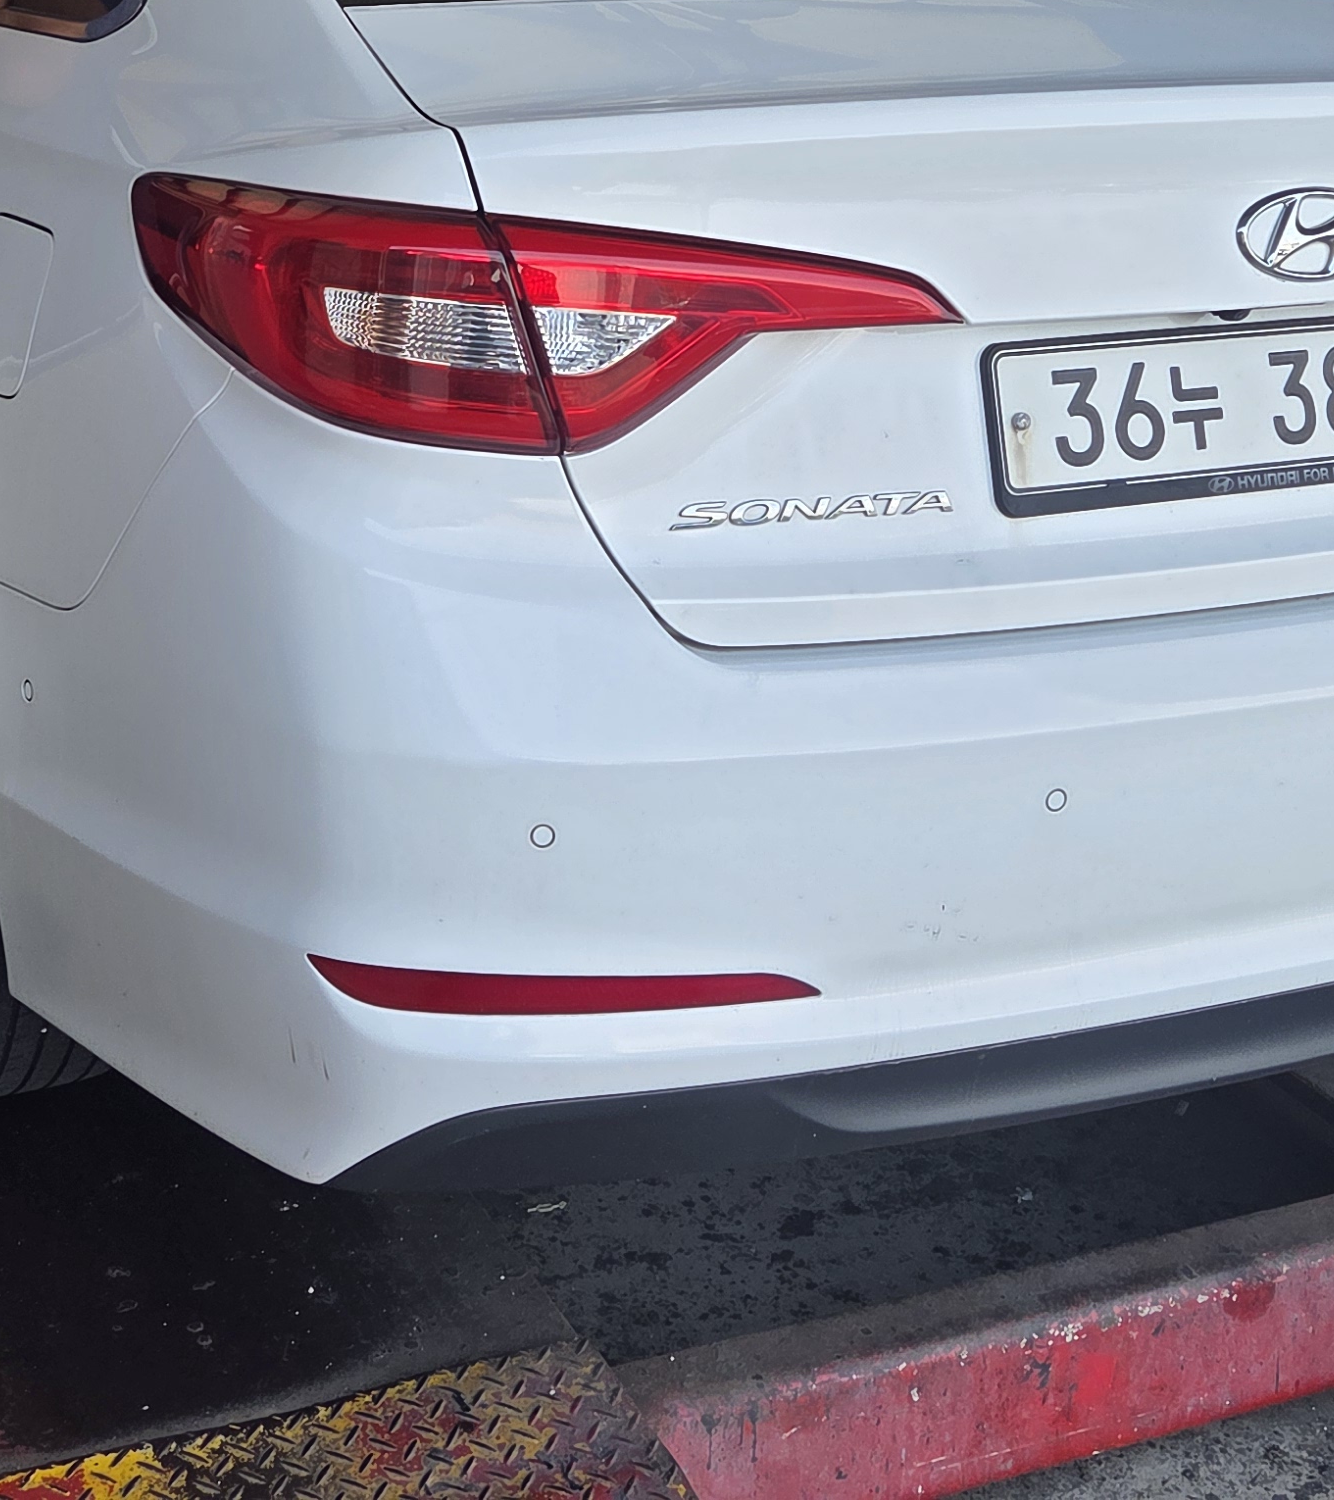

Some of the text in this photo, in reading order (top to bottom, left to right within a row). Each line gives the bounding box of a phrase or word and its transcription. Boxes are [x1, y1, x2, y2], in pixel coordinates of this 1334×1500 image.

[1050, 361, 1224, 468] 36누
[1237, 470, 1301, 490] HYUNDAI
[1303, 467, 1330, 483] FOR
[667, 488, 955, 532] SONATA
